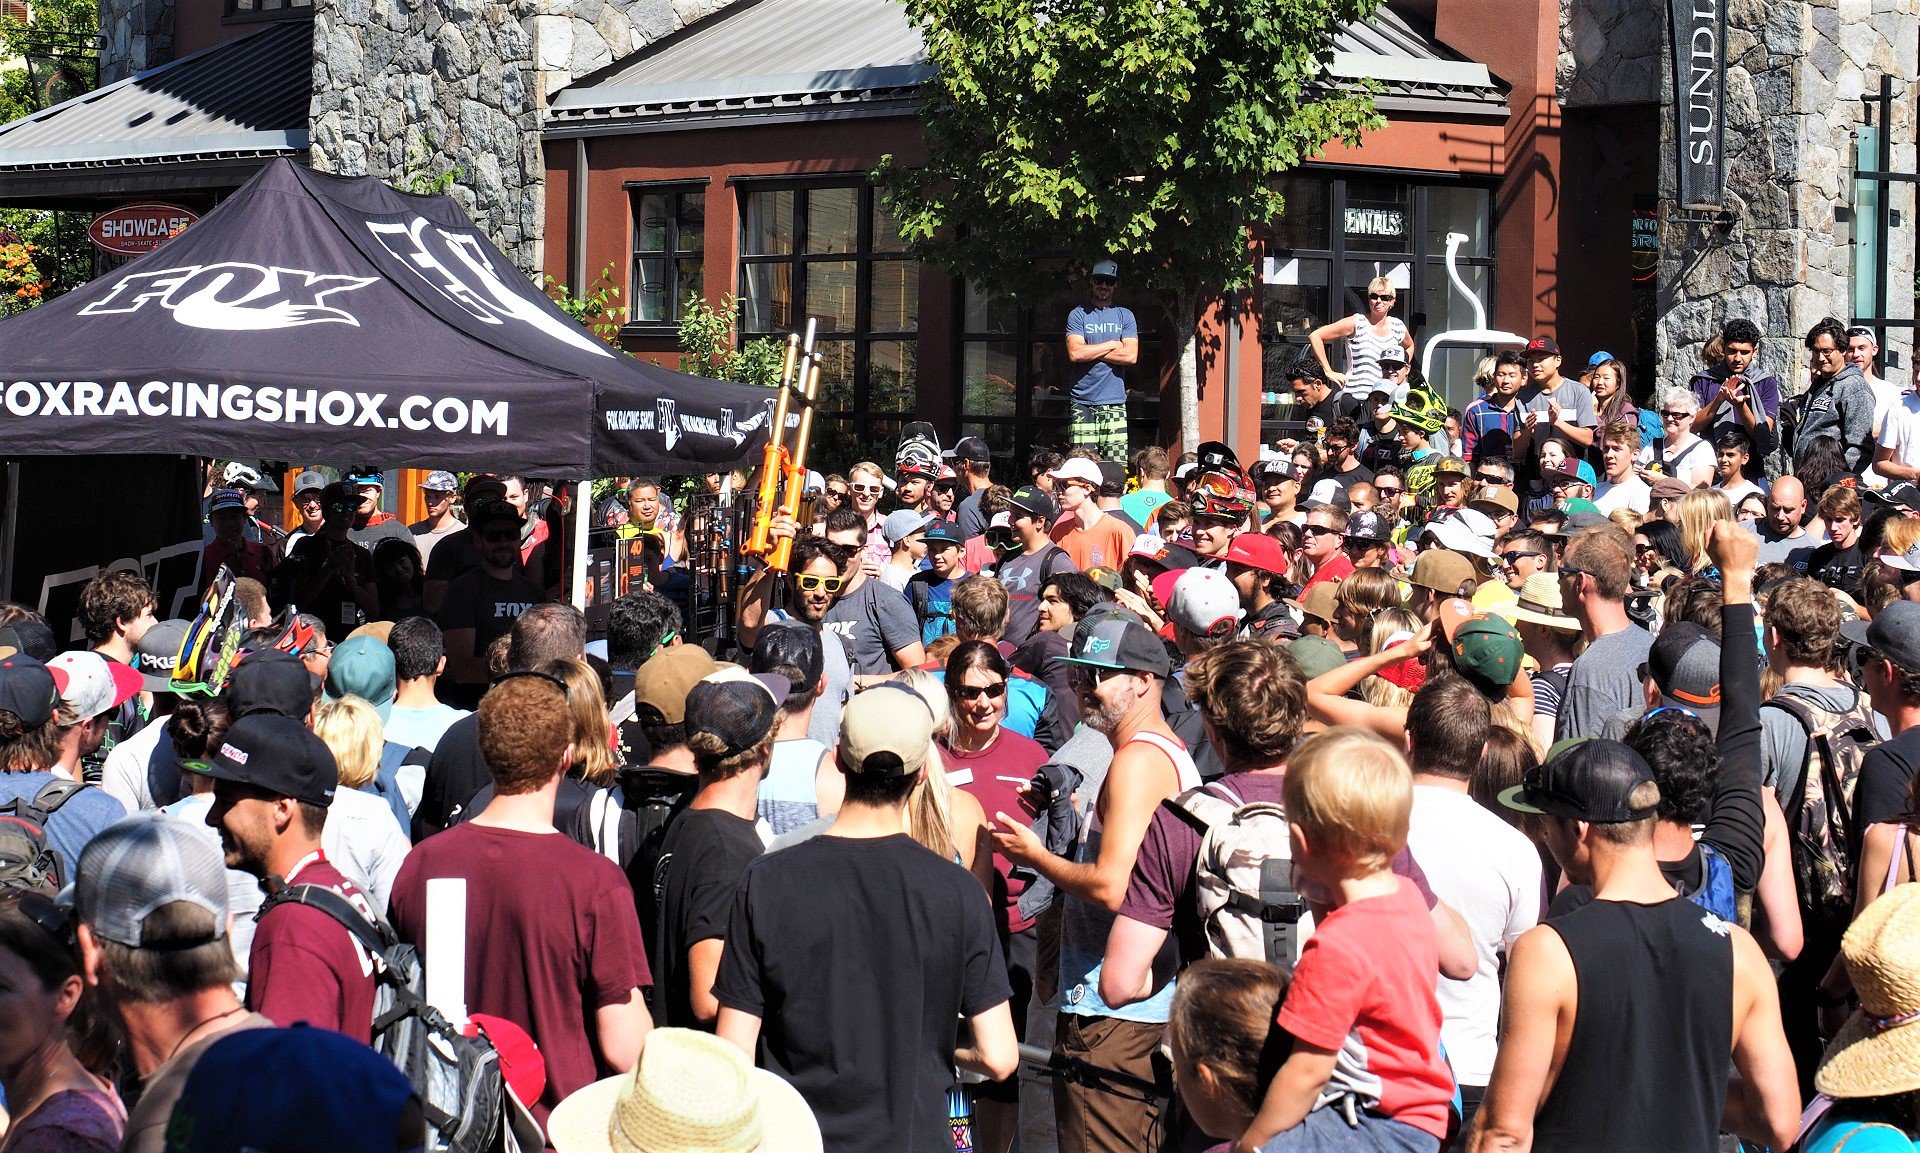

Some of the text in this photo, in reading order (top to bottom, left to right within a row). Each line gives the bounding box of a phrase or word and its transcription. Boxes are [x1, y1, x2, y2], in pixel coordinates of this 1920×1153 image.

[1690, 0, 1716, 165] SUNDI
[1345, 208, 1403, 236] ENTALS
[77, 262, 381, 330] FOX
[1086, 323, 1122, 333] SMITH
[0, 381, 509, 436] OXRACINGSHOX.COM
